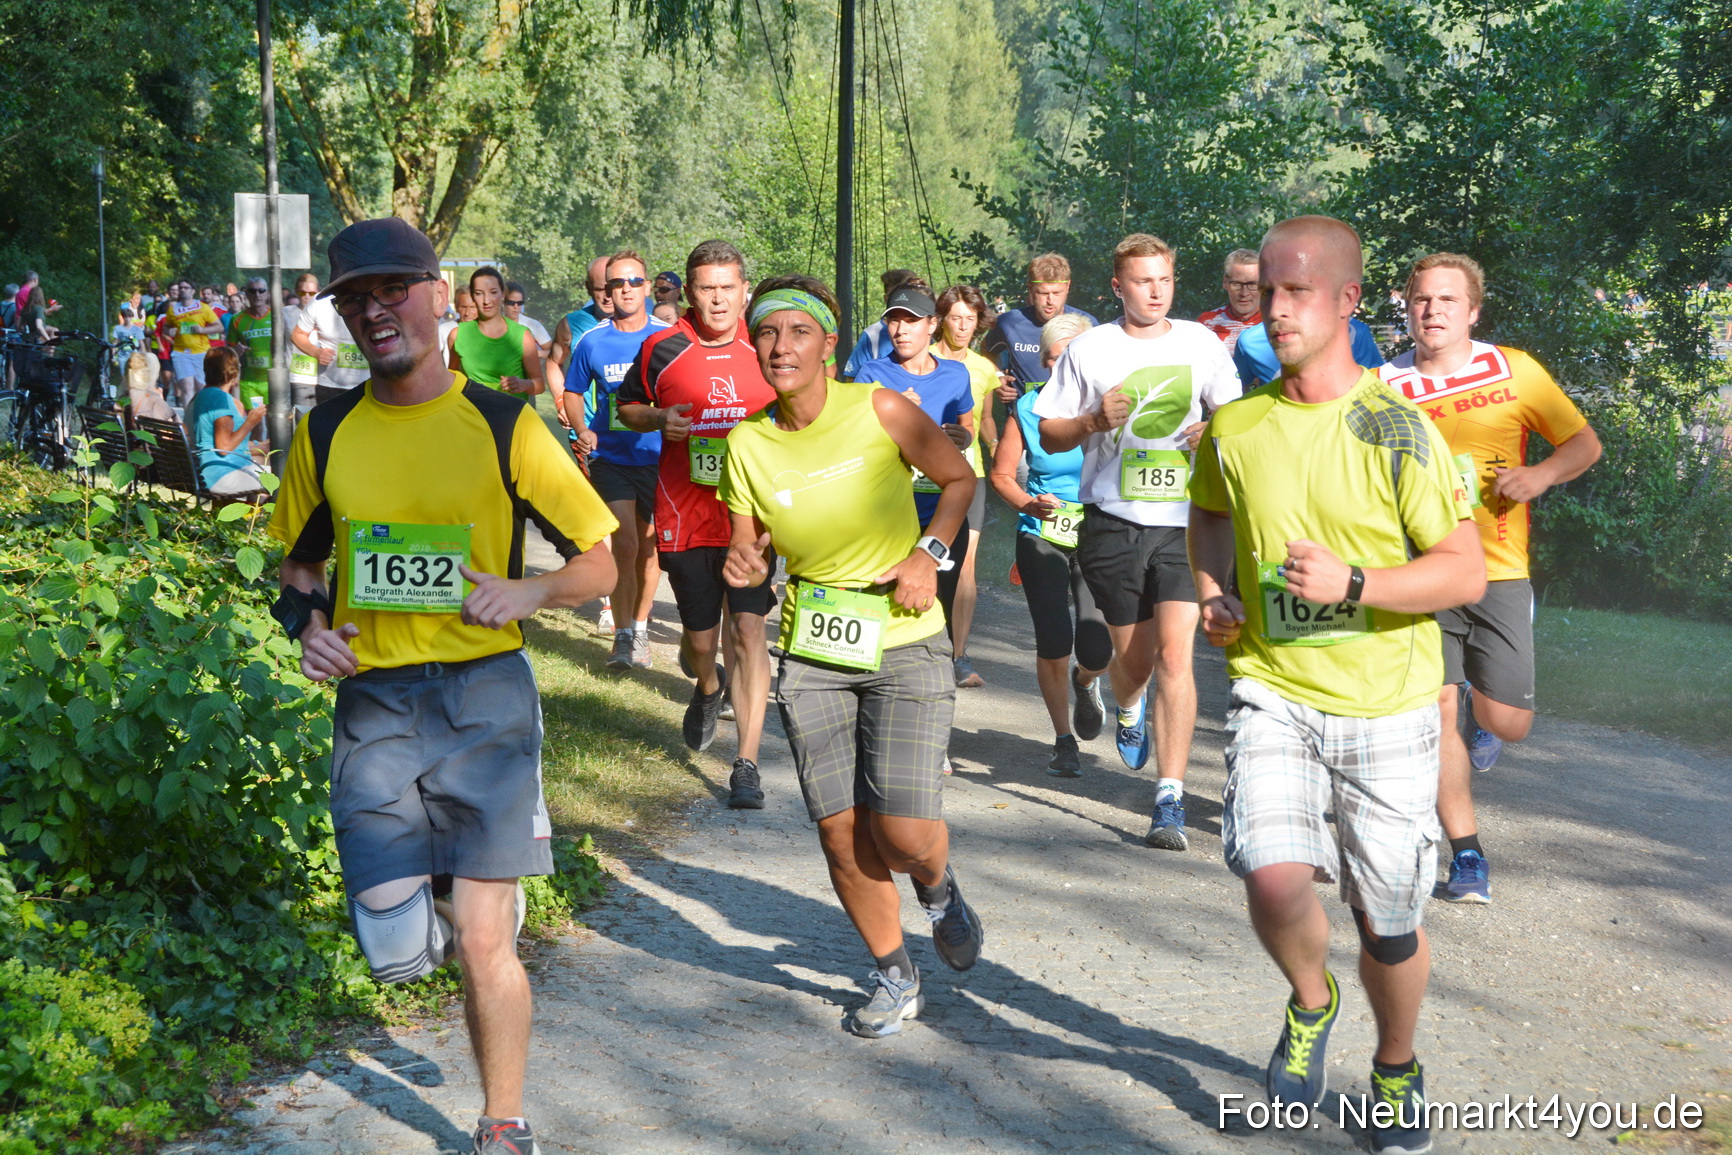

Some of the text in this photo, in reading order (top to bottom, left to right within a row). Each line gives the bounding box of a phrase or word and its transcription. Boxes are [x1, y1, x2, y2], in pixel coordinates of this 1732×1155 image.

[1014, 342, 1040, 353] EURO
[1453, 388, 1518, 413] BÖGL
[701, 407, 747, 420] MEYER
[1138, 467, 1175, 487] 185
[364, 553, 454, 588] 1632
[364, 585, 453, 597] Bergrath Alexander
[401, 596, 425, 605] Stiftung
[426, 596, 463, 604] Lauterhofen
[1273, 592, 1357, 623] 1624
[810, 612, 862, 645] 960
[1285, 621, 1346, 632] Bayer Michael
[805, 637, 865, 655] Schneck Cornelia
